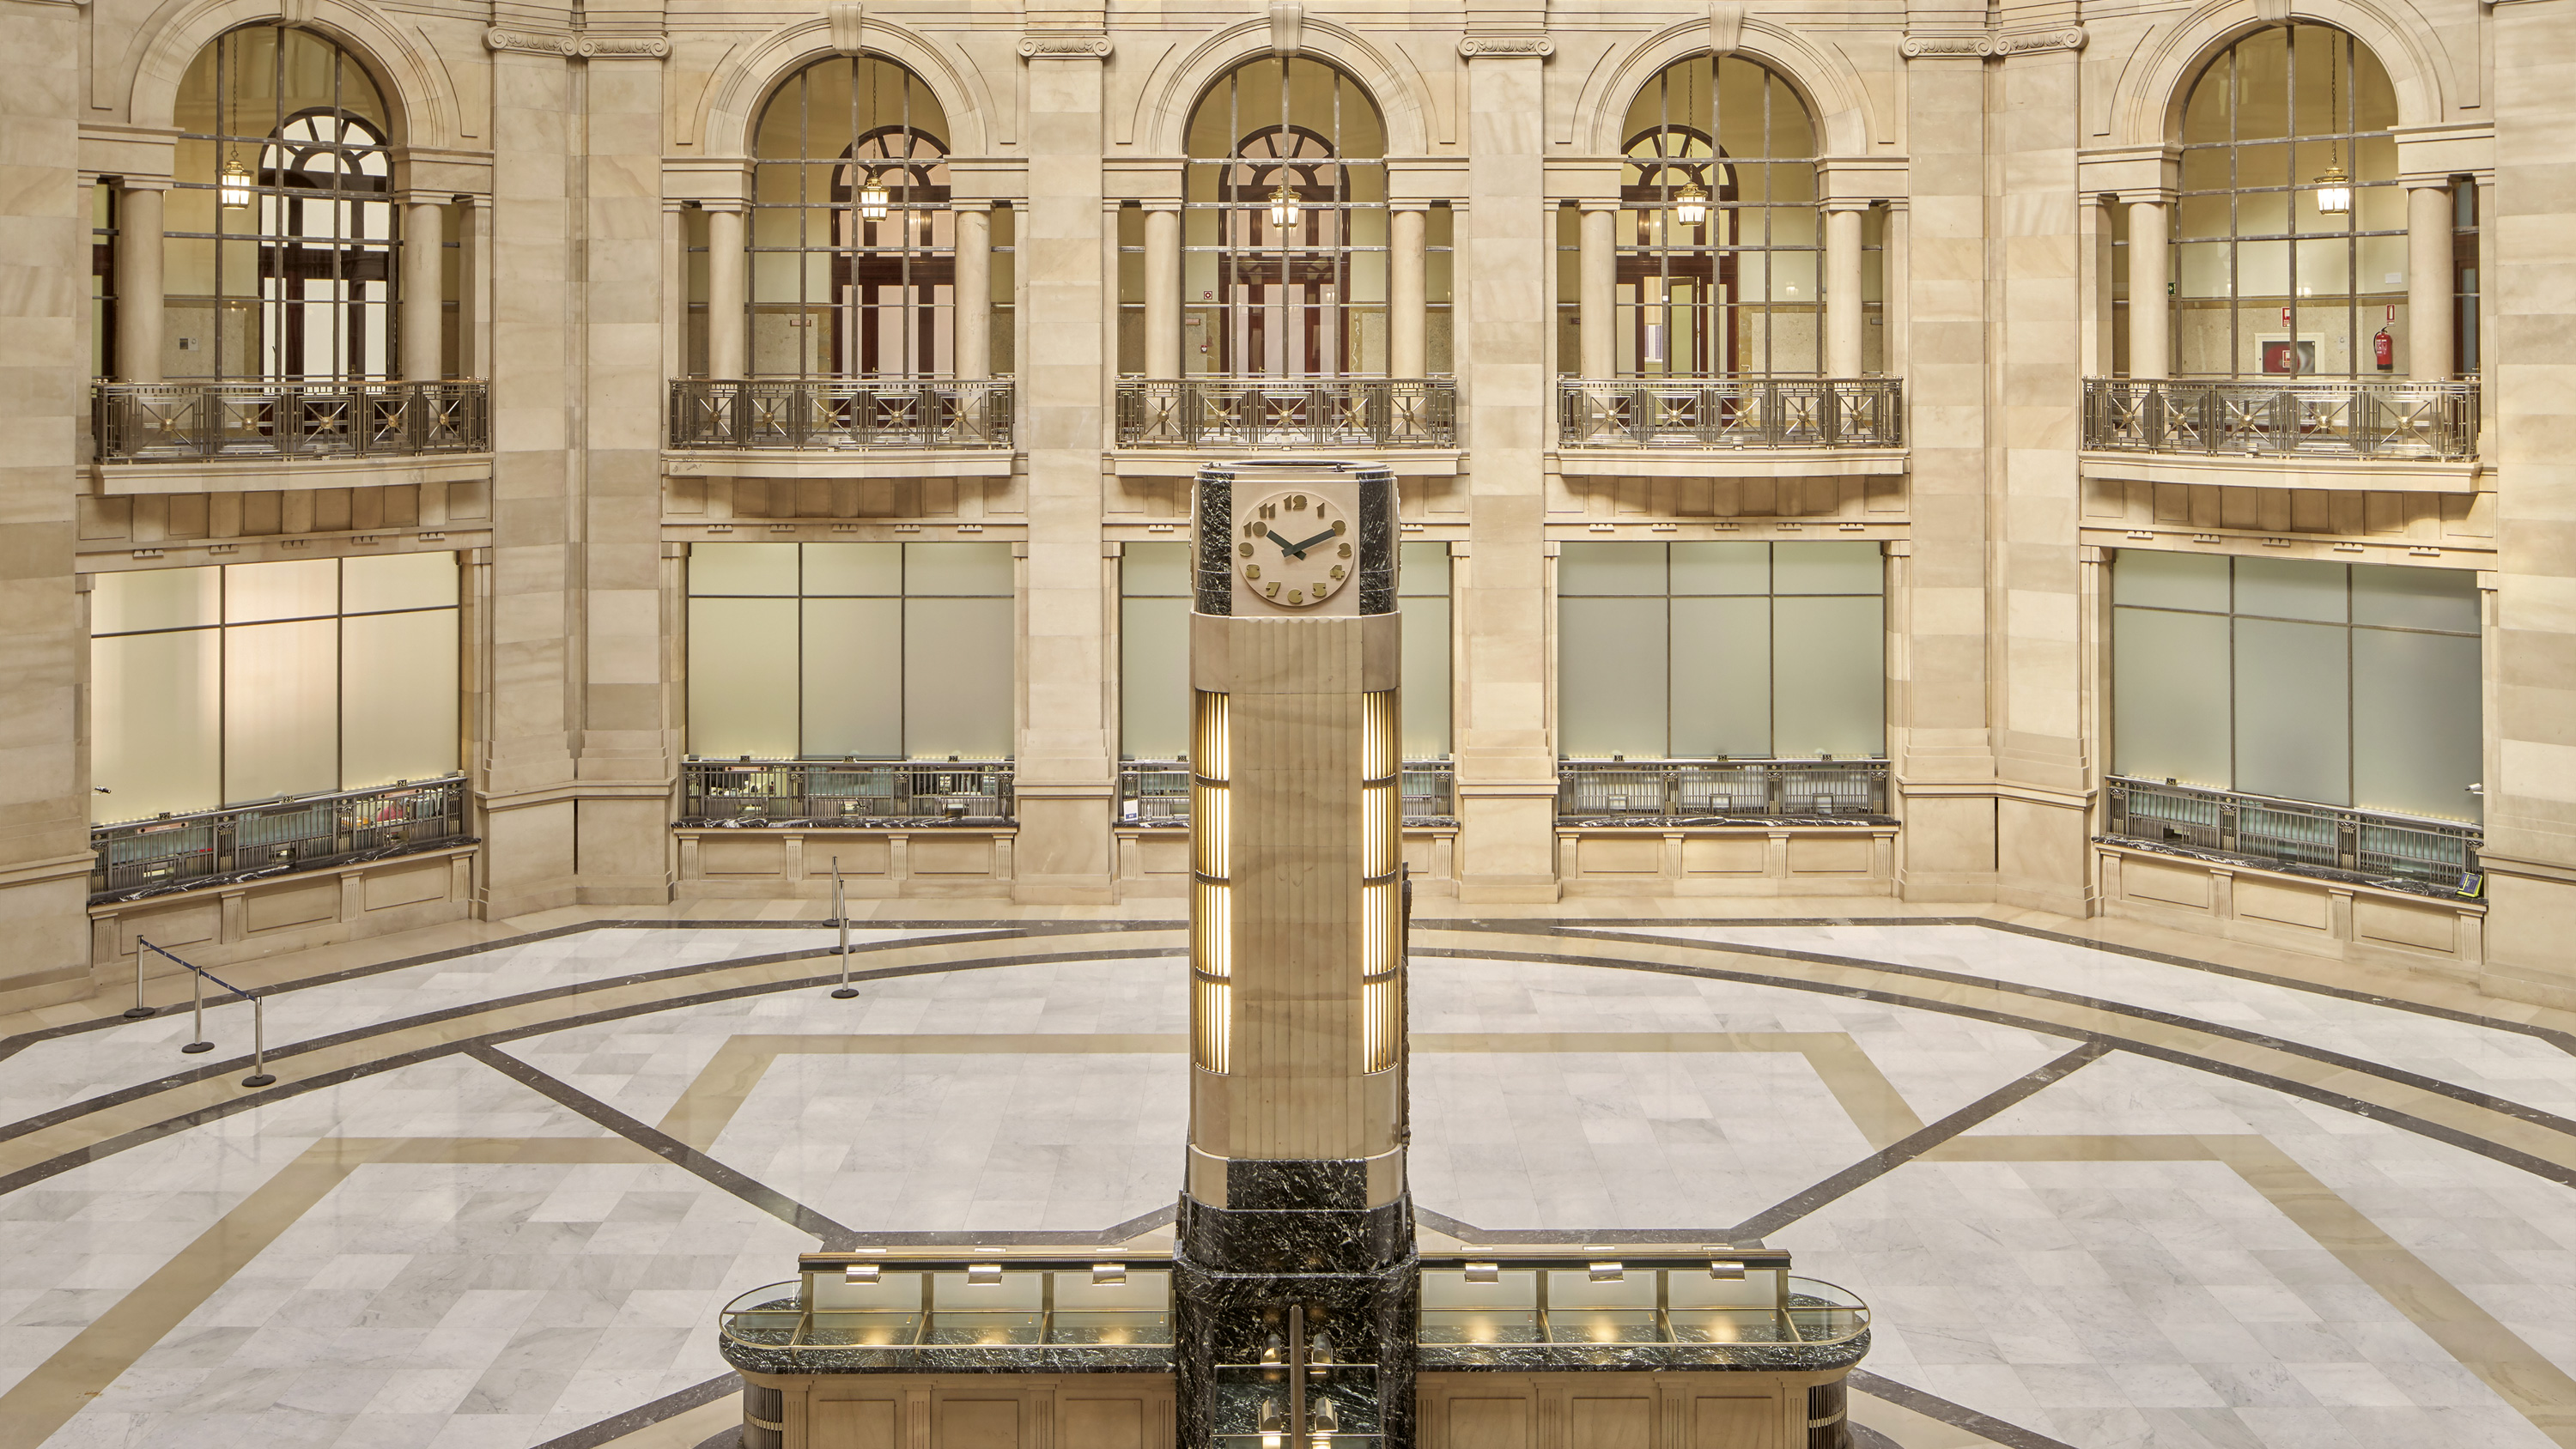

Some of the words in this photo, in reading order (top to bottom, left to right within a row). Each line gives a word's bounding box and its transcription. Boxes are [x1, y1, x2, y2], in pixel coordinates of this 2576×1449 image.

[1283, 494, 1308, 511] 12
[1316, 502, 1325, 518] 1
[1258, 503, 1276, 518] 11
[1242, 521, 1267, 537] 10
[1332, 519, 1346, 536] 2
[1238, 542, 1255, 557] 9
[1337, 543, 1352, 558] 3
[1245, 564, 1261, 579] 8
[1330, 564, 1346, 579] 4
[1266, 581, 1281, 597] 7
[1287, 589, 1303, 604] 6
[1312, 582, 1327, 597] 5
